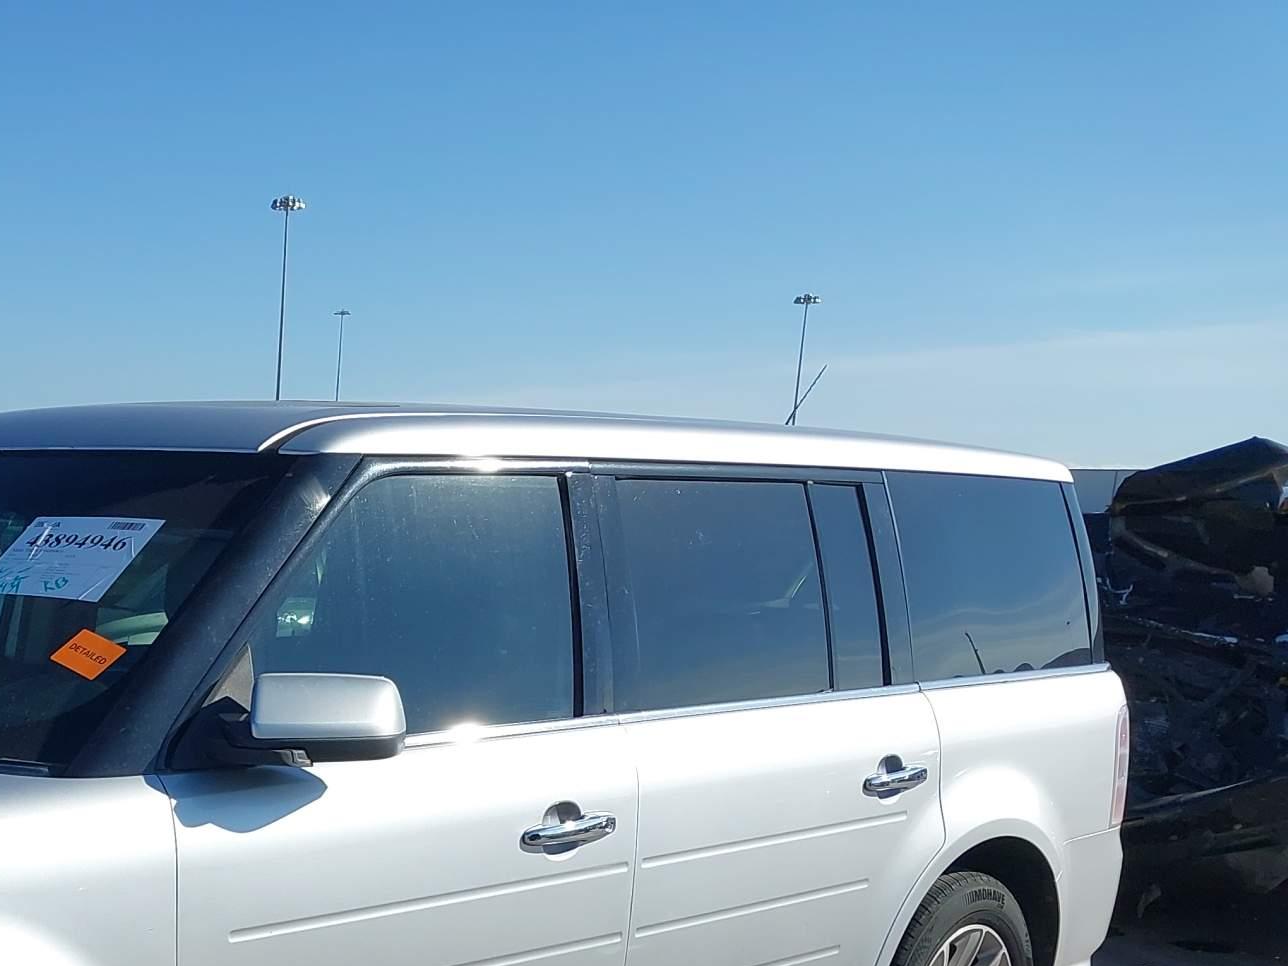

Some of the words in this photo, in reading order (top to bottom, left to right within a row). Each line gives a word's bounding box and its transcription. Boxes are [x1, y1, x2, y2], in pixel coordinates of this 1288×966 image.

[25, 533, 133, 552] 43894946
[68, 642, 108, 666] DETAILED
[973, 887, 1006, 906] MOHAVE
